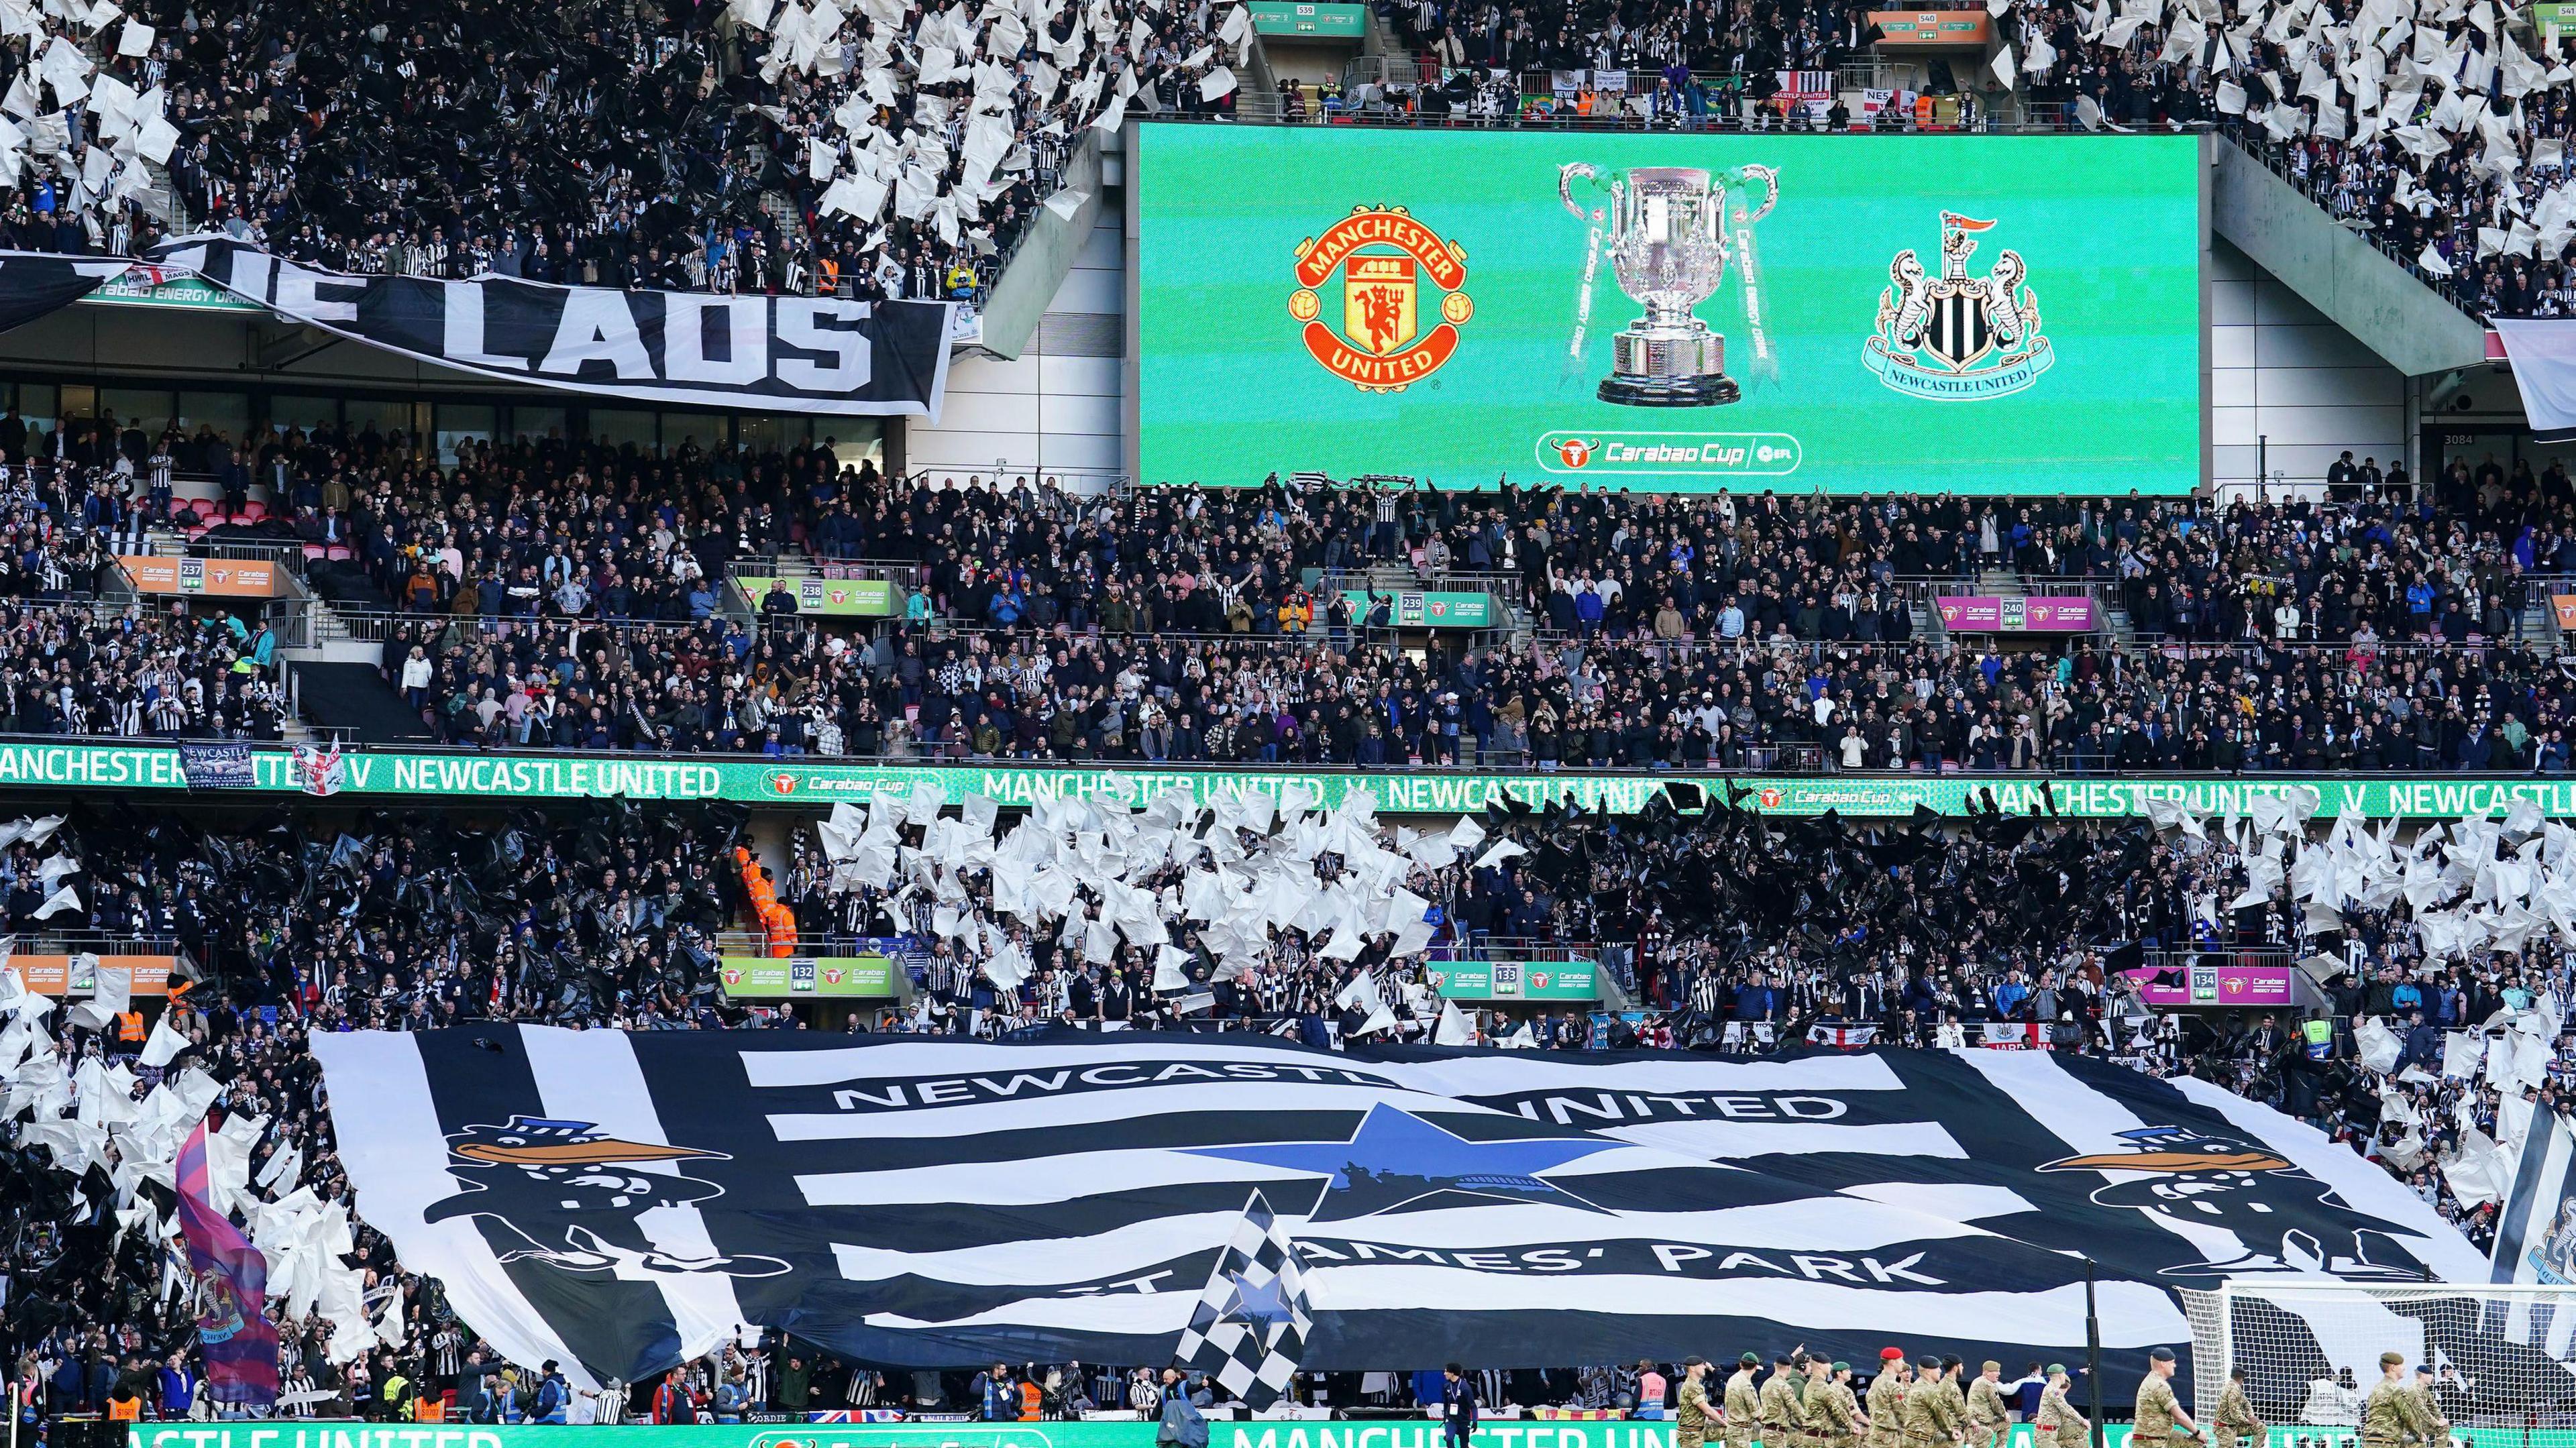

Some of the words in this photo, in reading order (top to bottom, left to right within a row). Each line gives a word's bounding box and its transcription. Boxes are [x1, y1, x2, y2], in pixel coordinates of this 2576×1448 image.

[1867, 91, 1888, 100] NE5
[1309, 219, 1453, 280] MANCHESTER
[155, 287, 213, 302] ENERGY
[1332, 348, 1432, 380] UNITED
[1889, 369, 1974, 393] NEWCASTLE
[1975, 369, 2027, 392] UNITED
[2445, 435, 2473, 445] 3084
[1605, 442, 1700, 463] Carabao
[1701, 443, 1745, 467] Cup
[1774, 448, 1792, 460] EFL
[142, 566, 174, 575] Carabao
[182, 565, 201, 575] 237
[237, 570, 269, 578] Carabao
[803, 586, 821, 596] 238
[1403, 598, 1422, 608] 239
[2004, 603, 2023, 614] 240
[182, 745, 250, 759] NEWCASTLE
[350, 758, 372, 787] V
[394, 759, 589, 794] NEWCASTLE
[596, 762, 721, 797] UNITED
[808, 777, 872, 792] Carabao
[873, 778, 905, 795] Cup
[1794, 789, 1856, 803] Carabao
[1859, 790, 1891, 807] Cup
[2343, 785, 2367, 813] V
[28, 966, 64, 974] Carabao
[135, 966, 170, 974] Carabao
[751, 968, 786, 977] Carabao
[793, 966, 813, 977] 132
[853, 968, 886, 977] Carabao
[1497, 970, 1516, 981] 133
[1454, 972, 1488, 980] Carabao
[2194, 974, 2214, 985] 134
[2252, 977, 2286, 985] Carabao
[833, 1062, 1395, 1110] NEWCASTL
[1293, 1241, 1604, 1272] AMES'
[1650, 1244, 1949, 1285] PARK
